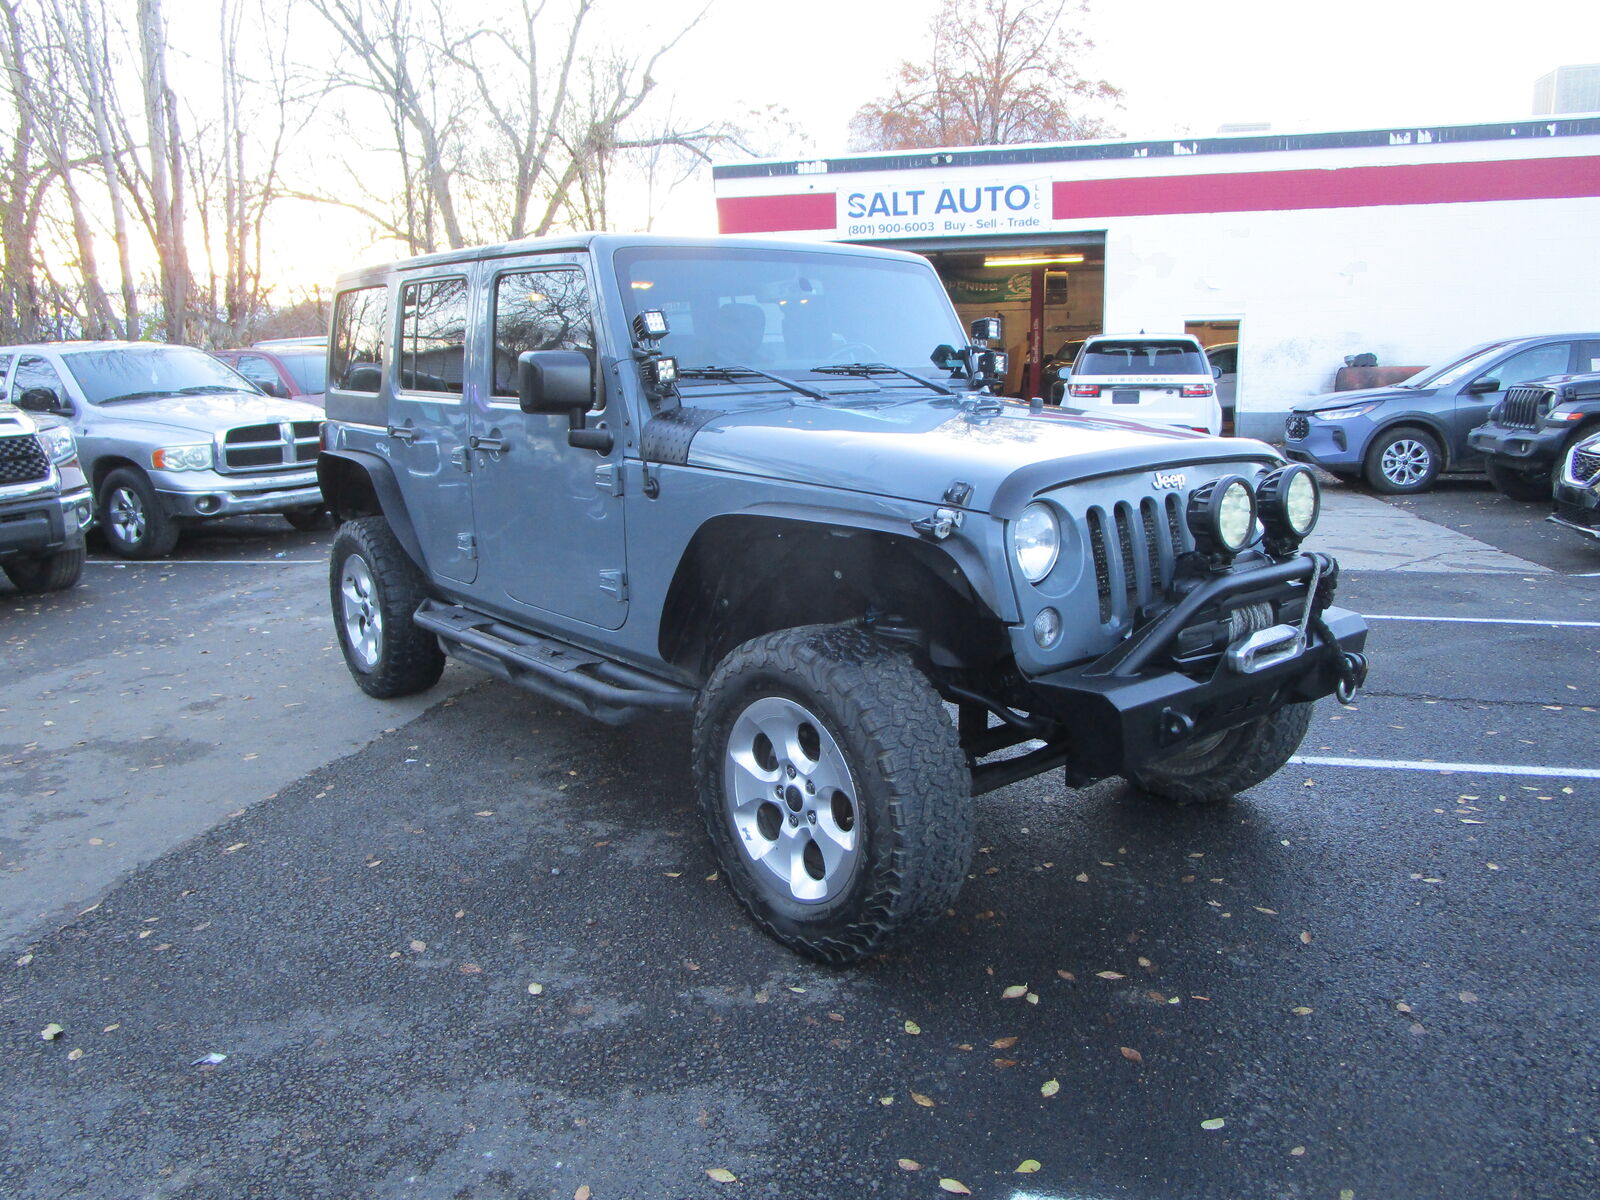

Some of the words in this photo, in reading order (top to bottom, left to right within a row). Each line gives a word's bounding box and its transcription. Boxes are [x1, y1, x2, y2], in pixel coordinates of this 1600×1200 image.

[848, 190, 925, 218] SALT
[935, 184, 1030, 214] AUTO
[848, 224, 875, 236] (801)
[878, 221, 935, 233] 900-6003
[944, 220, 966, 232] Buy
[976, 218, 997, 229] Sell
[1007, 217, 1040, 227] Trade
[1152, 472, 1185, 490] Jeep
